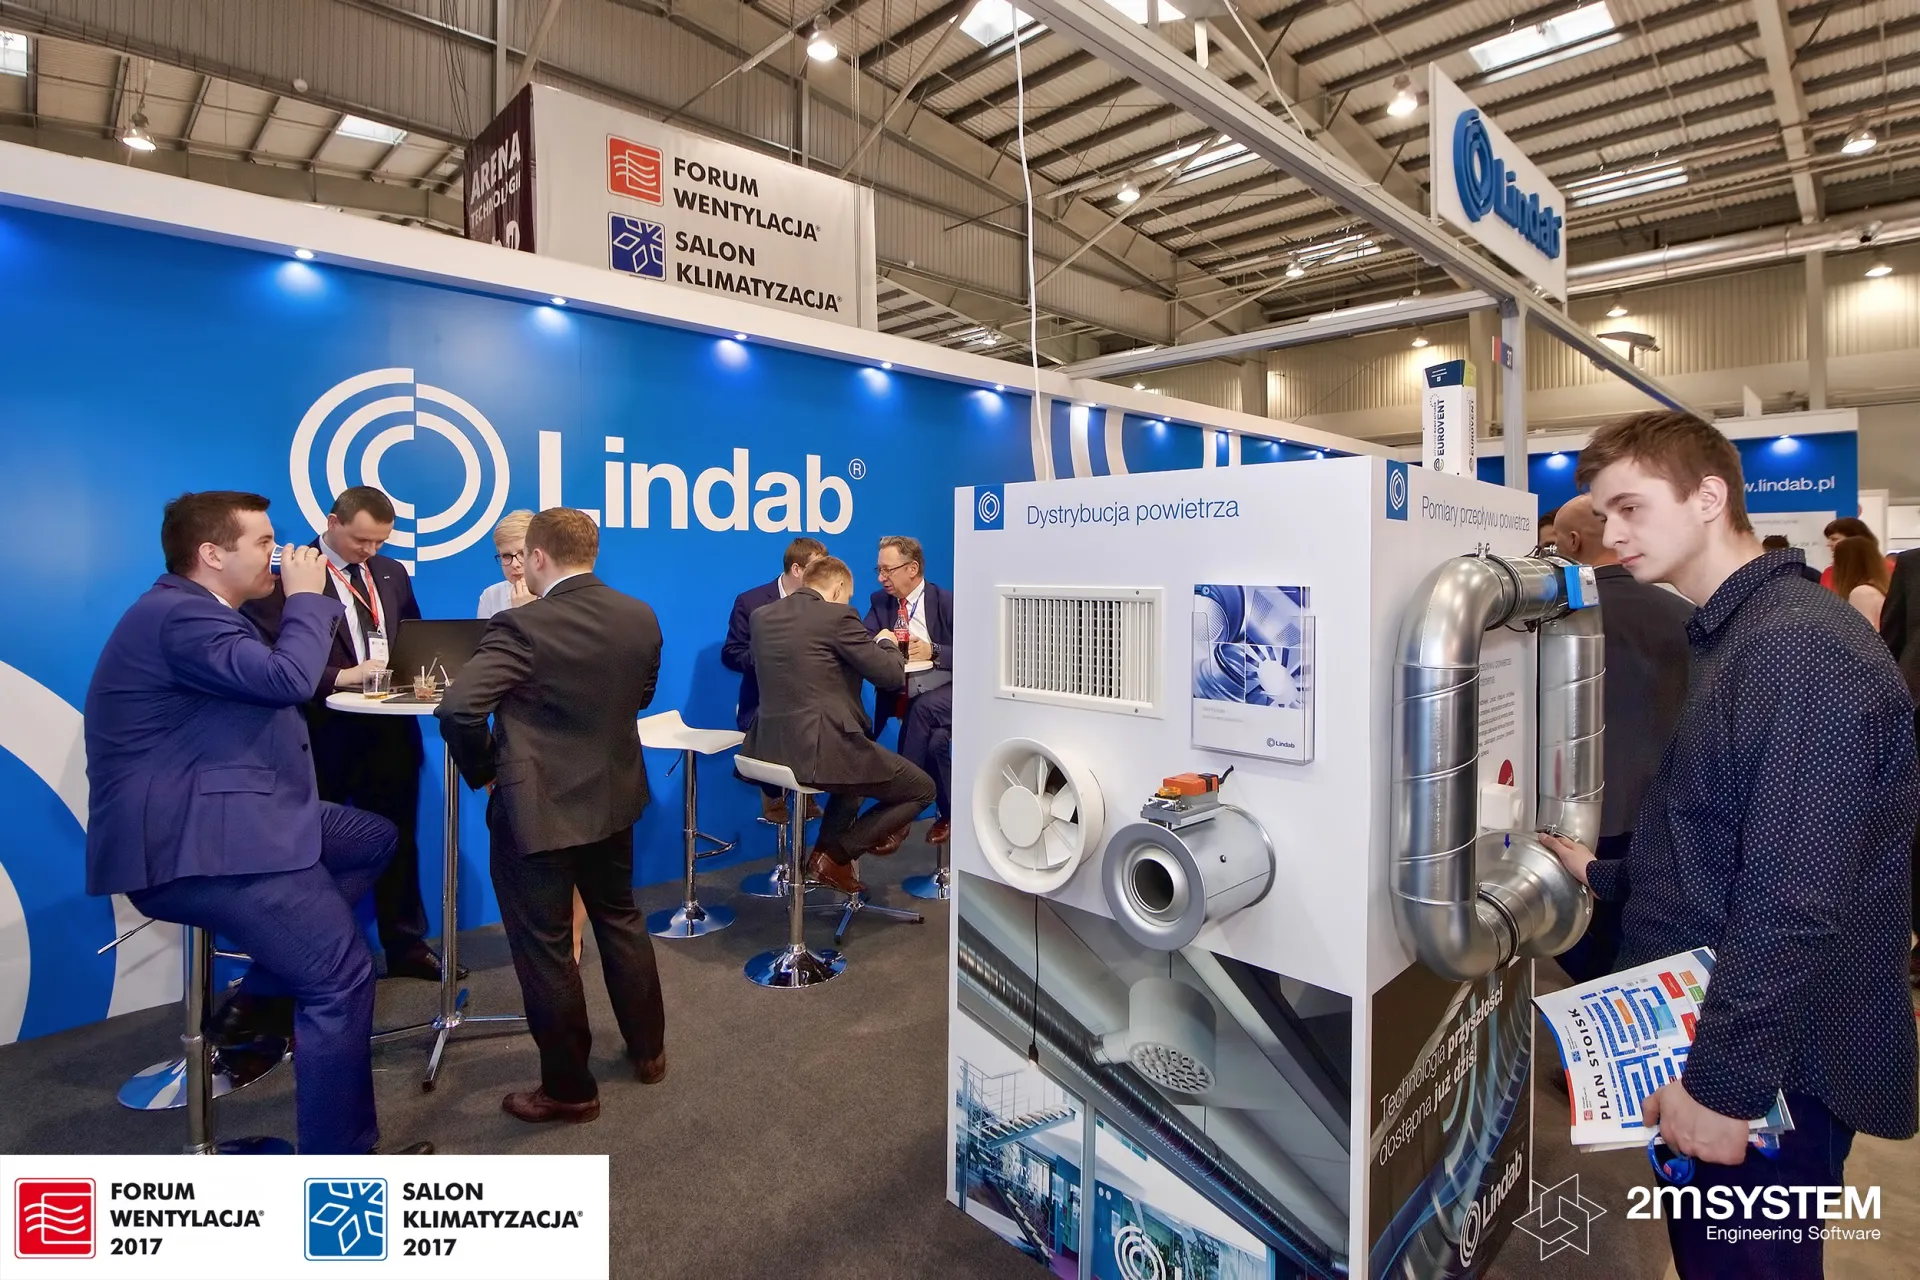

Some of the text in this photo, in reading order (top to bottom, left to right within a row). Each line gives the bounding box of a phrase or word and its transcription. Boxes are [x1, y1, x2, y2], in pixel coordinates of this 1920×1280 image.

[470, 130, 520, 206] ARENA
[673, 156, 760, 198] FORUM
[1493, 158, 1562, 260] Lindab
[675, 230, 756, 267] SALON
[1437, 399, 1445, 456] EUROVENT
[1027, 497, 1240, 529] Dystrybucja powietrza
[1422, 495, 1459, 527] Pomiary
[1500, 512, 1530, 532] powietrza
[1275, 740, 1296, 749] Lindab
[1380, 981, 1503, 1123] Technologia przyszłości
[1568, 1008, 1600, 1067] STOISK
[1379, 1096, 1433, 1166] dostępna
[1433, 1073, 1451, 1112] już
[1594, 1074, 1612, 1121] PLAN
[1482, 1149, 1523, 1229] Lindab
